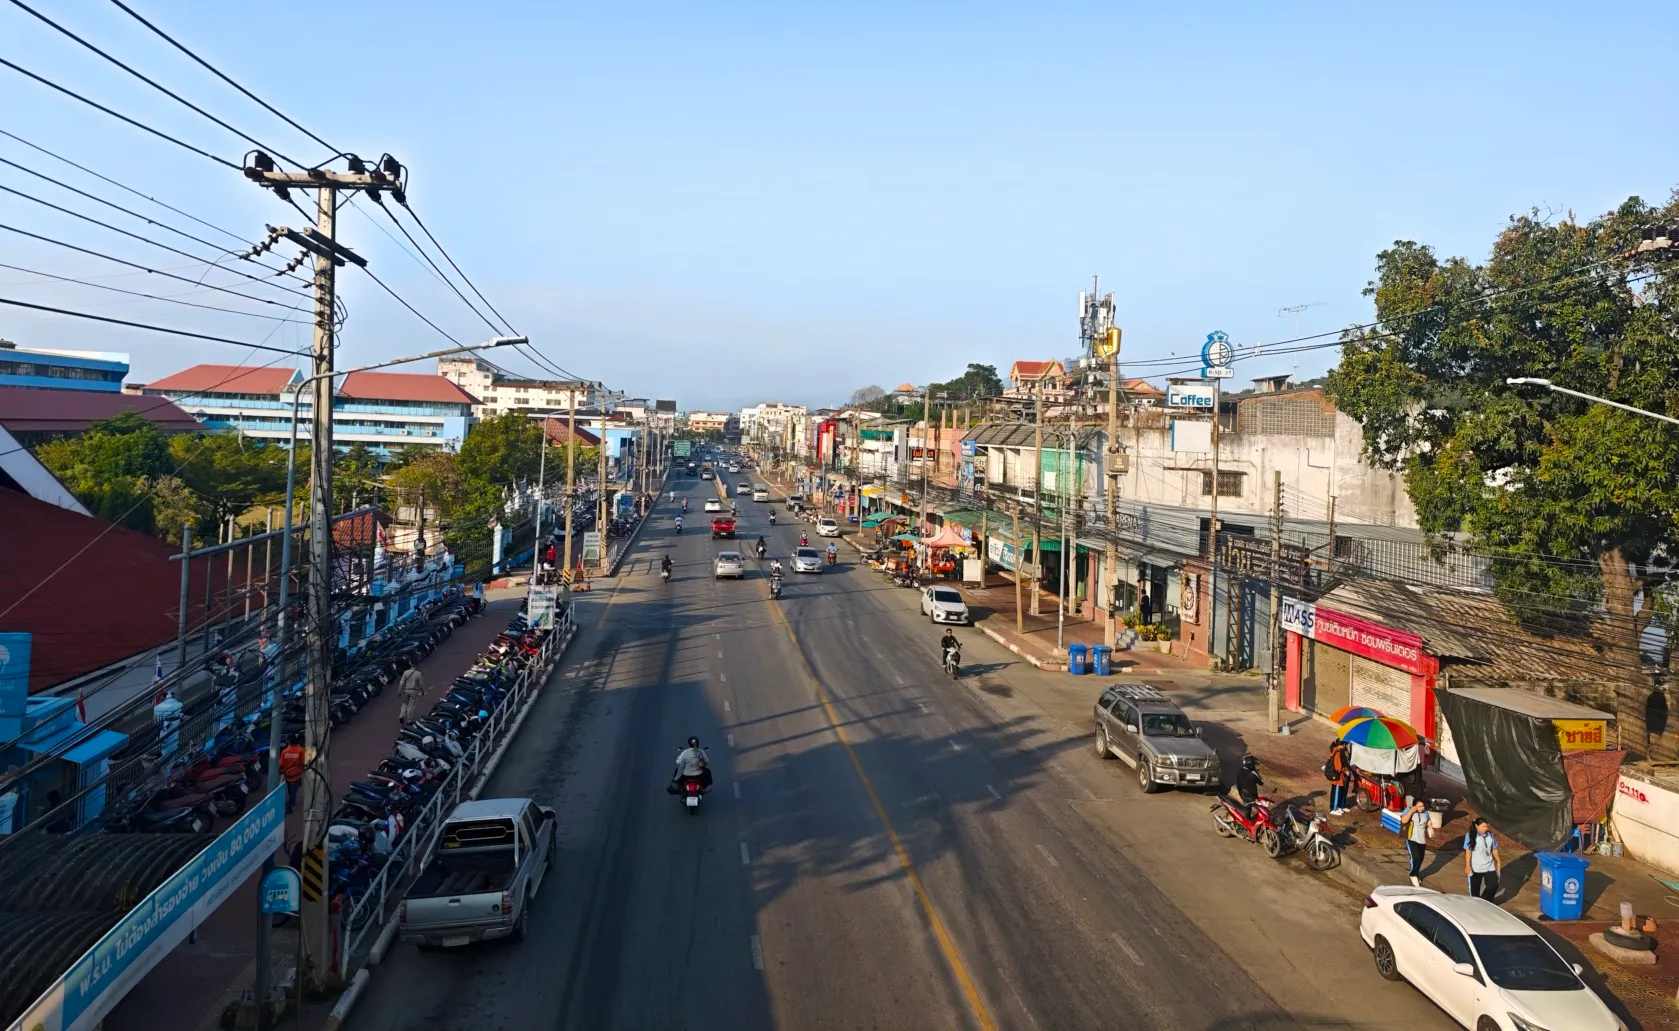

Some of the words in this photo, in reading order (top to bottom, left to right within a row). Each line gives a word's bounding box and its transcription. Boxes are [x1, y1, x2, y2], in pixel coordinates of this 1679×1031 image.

[1170, 393, 1212, 406] Coffee
[1284, 603, 1314, 628] MASS
[230, 817, 261, 857] 80,000
[261, 807, 275, 828] บาท
